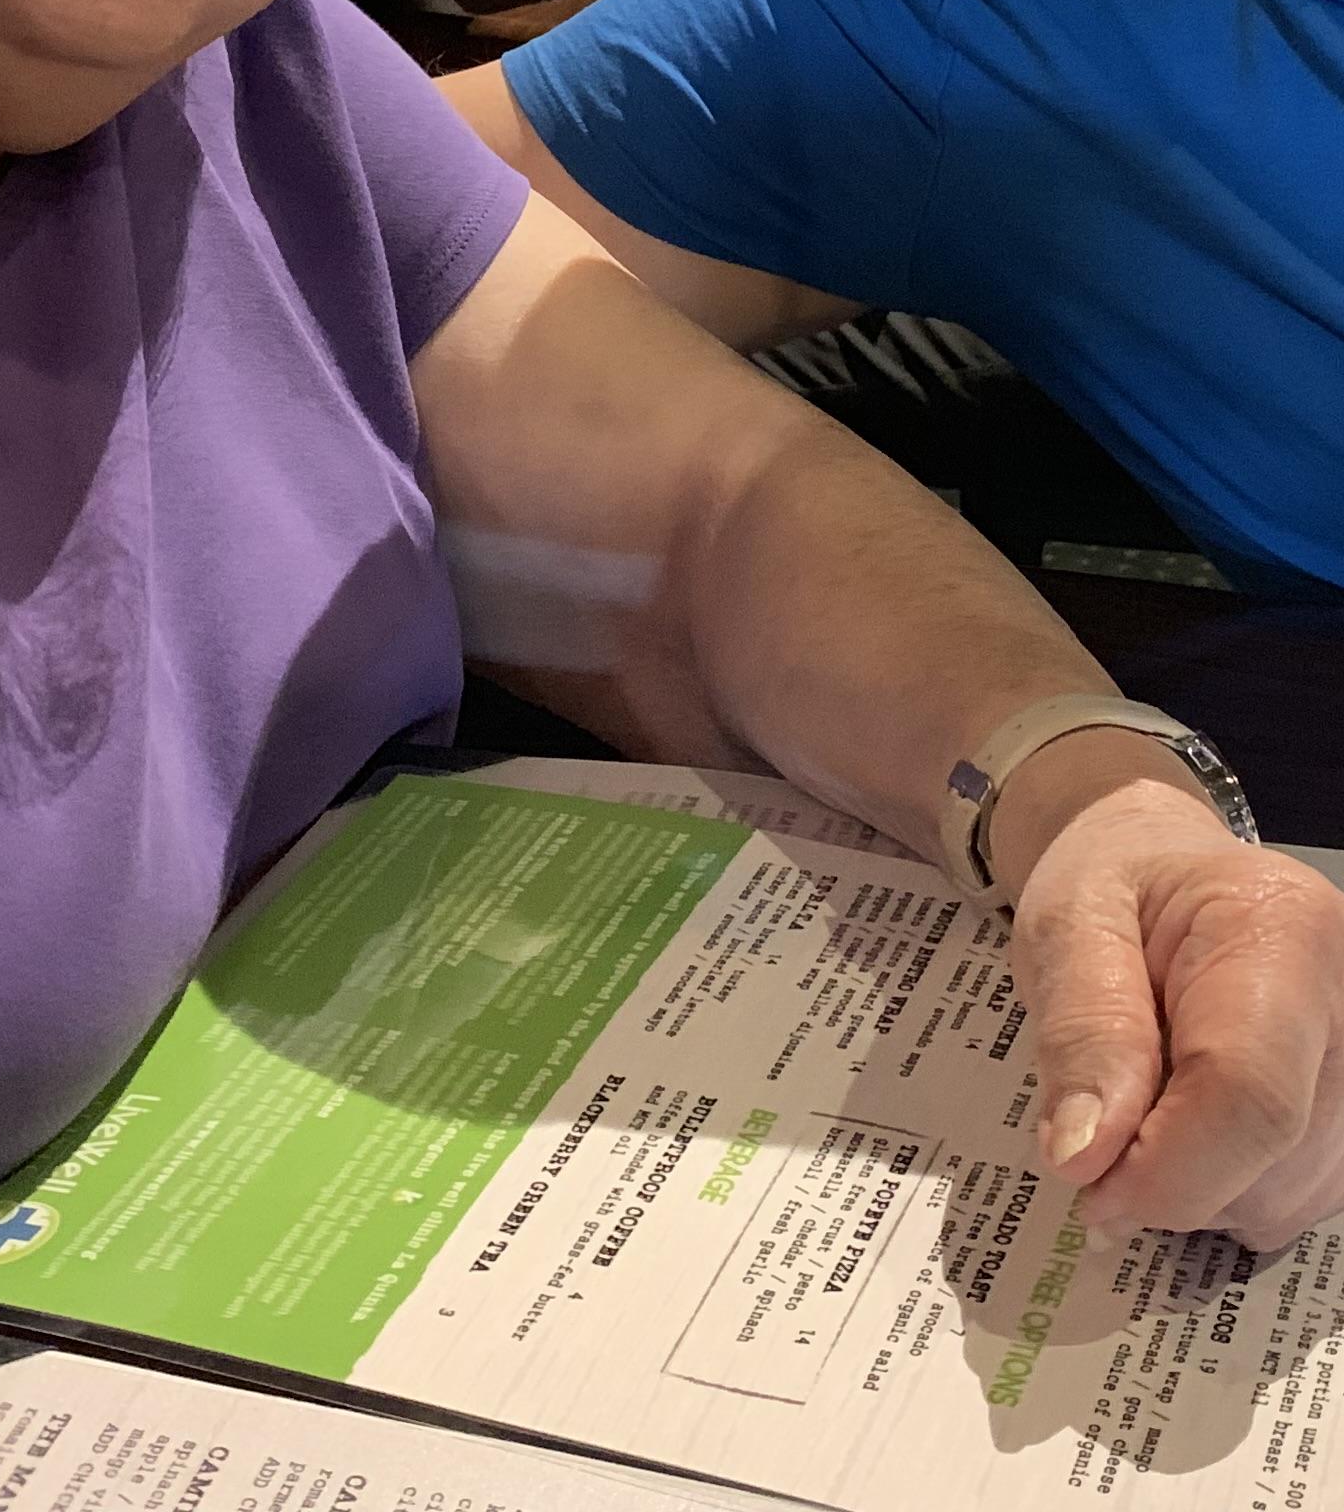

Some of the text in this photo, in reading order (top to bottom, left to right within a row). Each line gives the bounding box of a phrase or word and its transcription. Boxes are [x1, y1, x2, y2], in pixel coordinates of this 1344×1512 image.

[35, 1092, 161, 1194] LiveWell
[696, 1108, 779, 1206] BEVERAGE
[925, 1154, 962, 1209] or fruit
[437, 1073, 626, 1317] BLACKBERRY GREEN TEA 3
[510, 1089, 689, 1342] coffee blended with grass-fed butter
[566, 1095, 718, 1300] BULLETPROOF COFFEE 4
[734, 1131, 866, 1343] mozzarella cheddar spinach
[739, 1126, 845, 1285] broccoli fresh garlic
[782, 1137, 890, 1311] gluten free crust pesto
[793, 1143, 919, 1345] THE POPEYE PIZZA 14
[861, 1160, 987, 1392] tomato choice of organic salad
[908, 1164, 1012, 1357] gluten free bread avocado
[945, 1169, 1041, 1337] AVOCADO TOAST 7
[1028, 1258, 1077, 1309] FREE
[983, 1310, 1053, 1409] OPTIONS
[1261, 1233, 1342, 1474] calories 3.5oz chicken breast
[1305, 1360, 1335, 1420] portion
[26, 1413, 71, 1458] THE
[90, 1423, 119, 1455] ADD
[103, 1428, 145, 1480] mango
[129, 1435, 170, 1485] apple
[143, 1440, 196, 1510] spinach
[1293, 1426, 1318, 1473] under
[1284, 1479, 1307, 1508] 500
